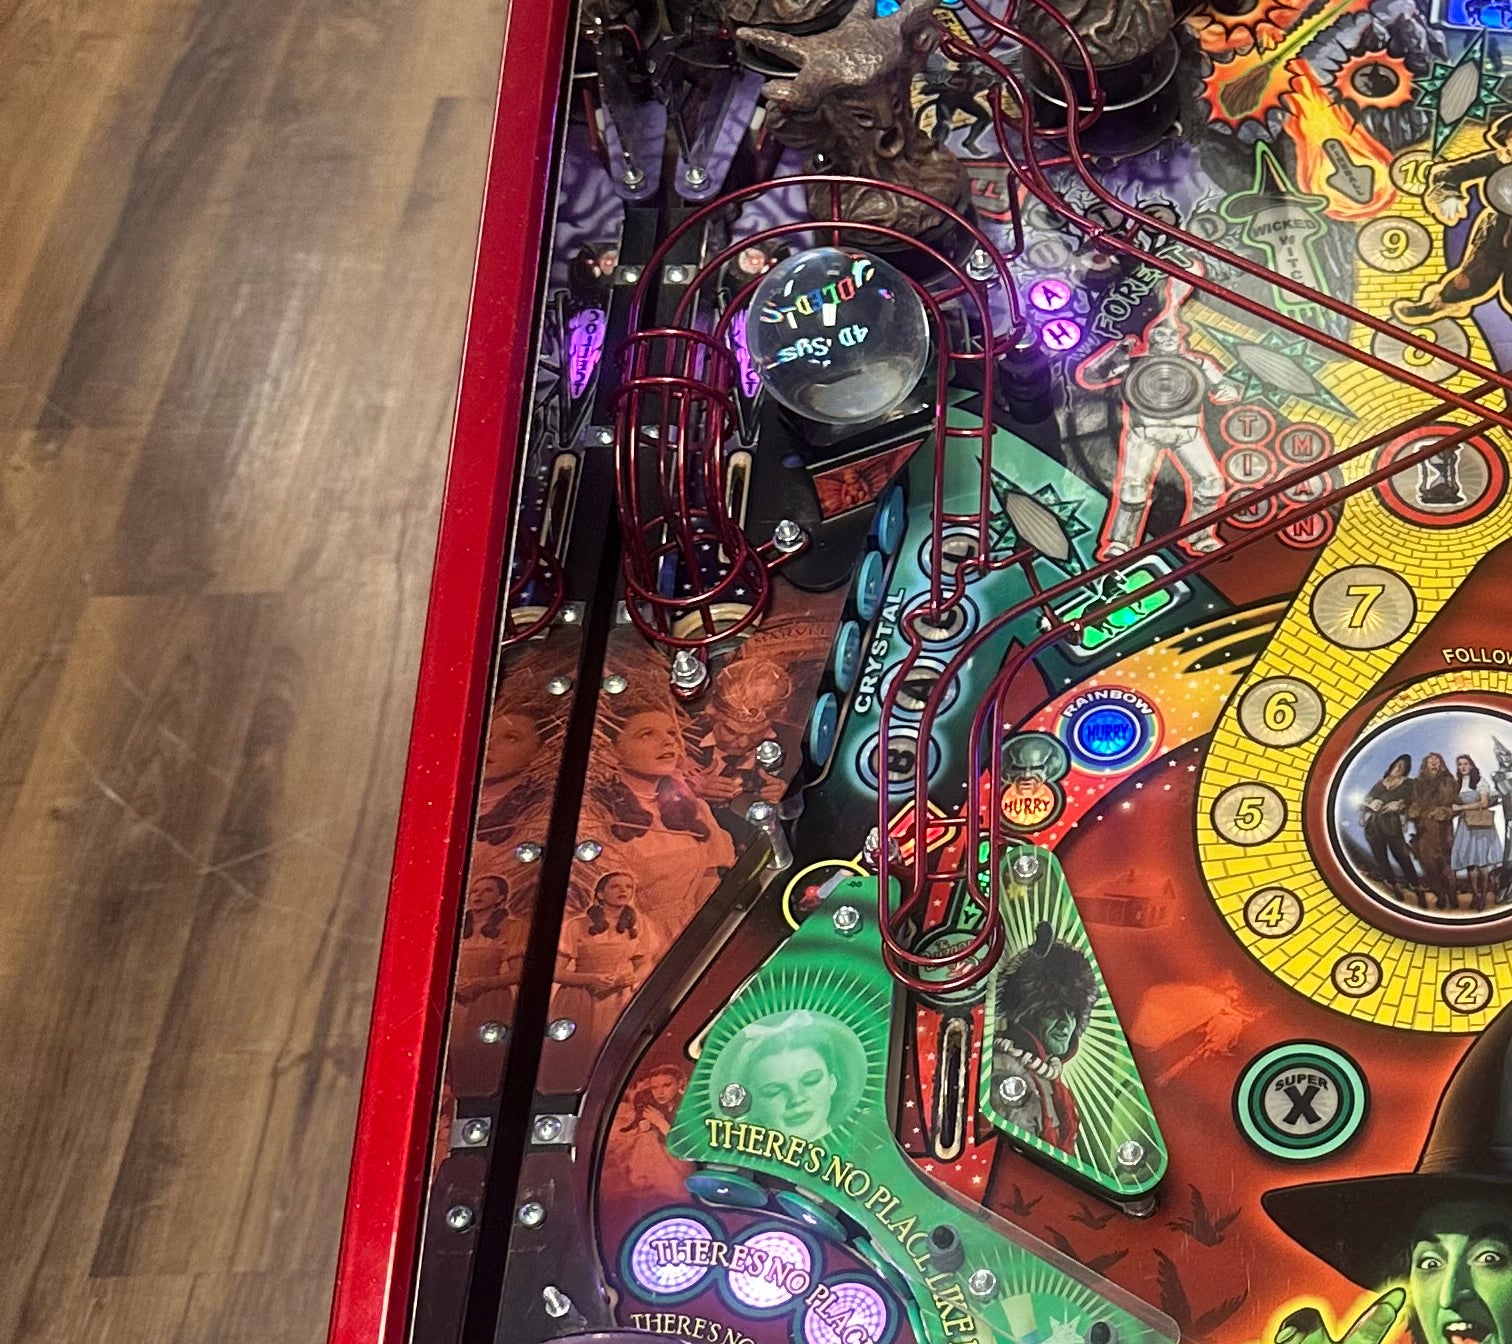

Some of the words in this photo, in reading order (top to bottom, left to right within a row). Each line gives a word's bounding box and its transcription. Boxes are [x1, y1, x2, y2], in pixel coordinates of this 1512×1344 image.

[1252, 218, 1318, 238] WICKED
[1380, 229, 1409, 260] 9
[1346, 584, 1386, 630] 7
[854, 587, 907, 714] CRYSTAL
[1062, 688, 1154, 719] RAINBOW
[1263, 691, 1297, 733] 6
[1086, 721, 1132, 743] HURRY
[1003, 797, 1051, 817] HURRY
[1233, 796, 1265, 832] 5
[1255, 895, 1285, 928] 4
[1343, 959, 1369, 990] 3
[1452, 977, 1479, 1007] 2
[1273, 1073, 1330, 1093] SUPER
[1281, 1086, 1323, 1126] X
[704, 1117, 826, 1174] THERE'S
[823, 1155, 872, 1198] NO
[924, 1271, 974, 1336] LIKE
[651, 1239, 766, 1280] THERE'S
[765, 1258, 811, 1294] NO
[630, 1312, 722, 1344] THERE'S
